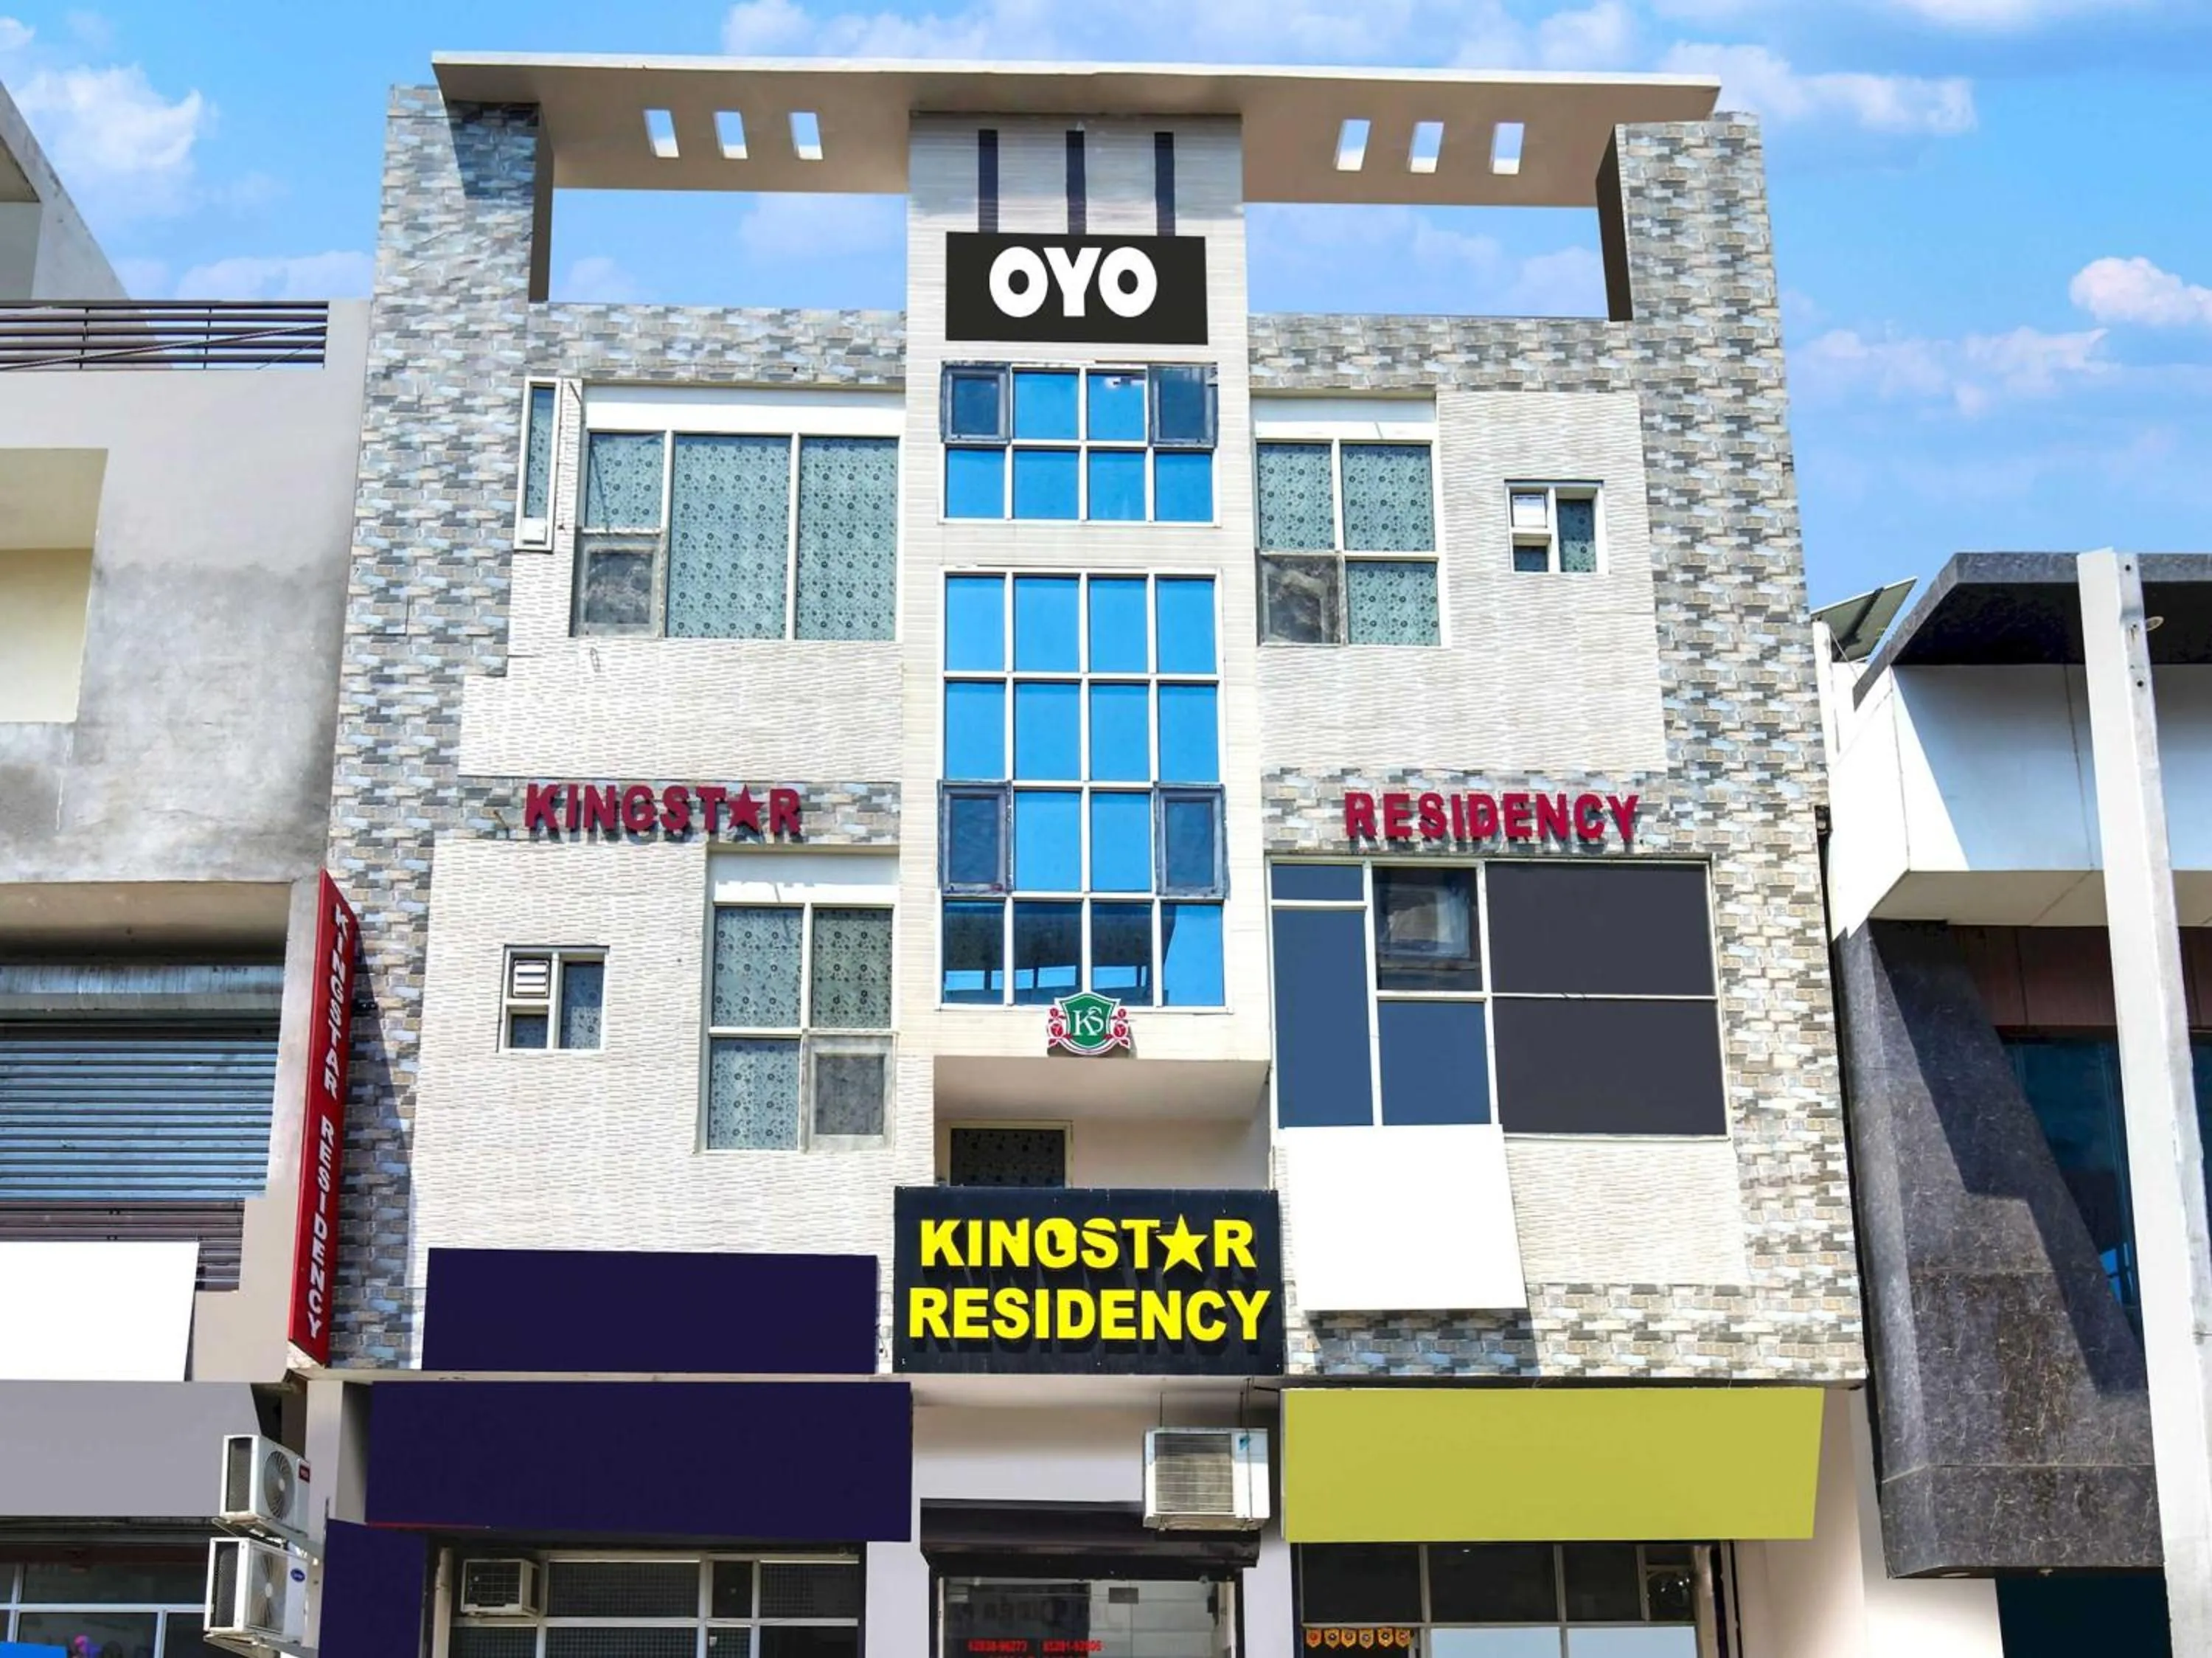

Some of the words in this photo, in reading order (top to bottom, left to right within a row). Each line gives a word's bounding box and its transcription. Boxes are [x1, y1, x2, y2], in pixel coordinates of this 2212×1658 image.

[989, 246, 1158, 318] OYO
[1344, 791, 1639, 842] RESIDENCY
[324, 902, 349, 1100] KINGSTAR
[307, 1114, 334, 1339] RESIDENCY
[909, 1287, 1271, 1342] RESIDENCY
